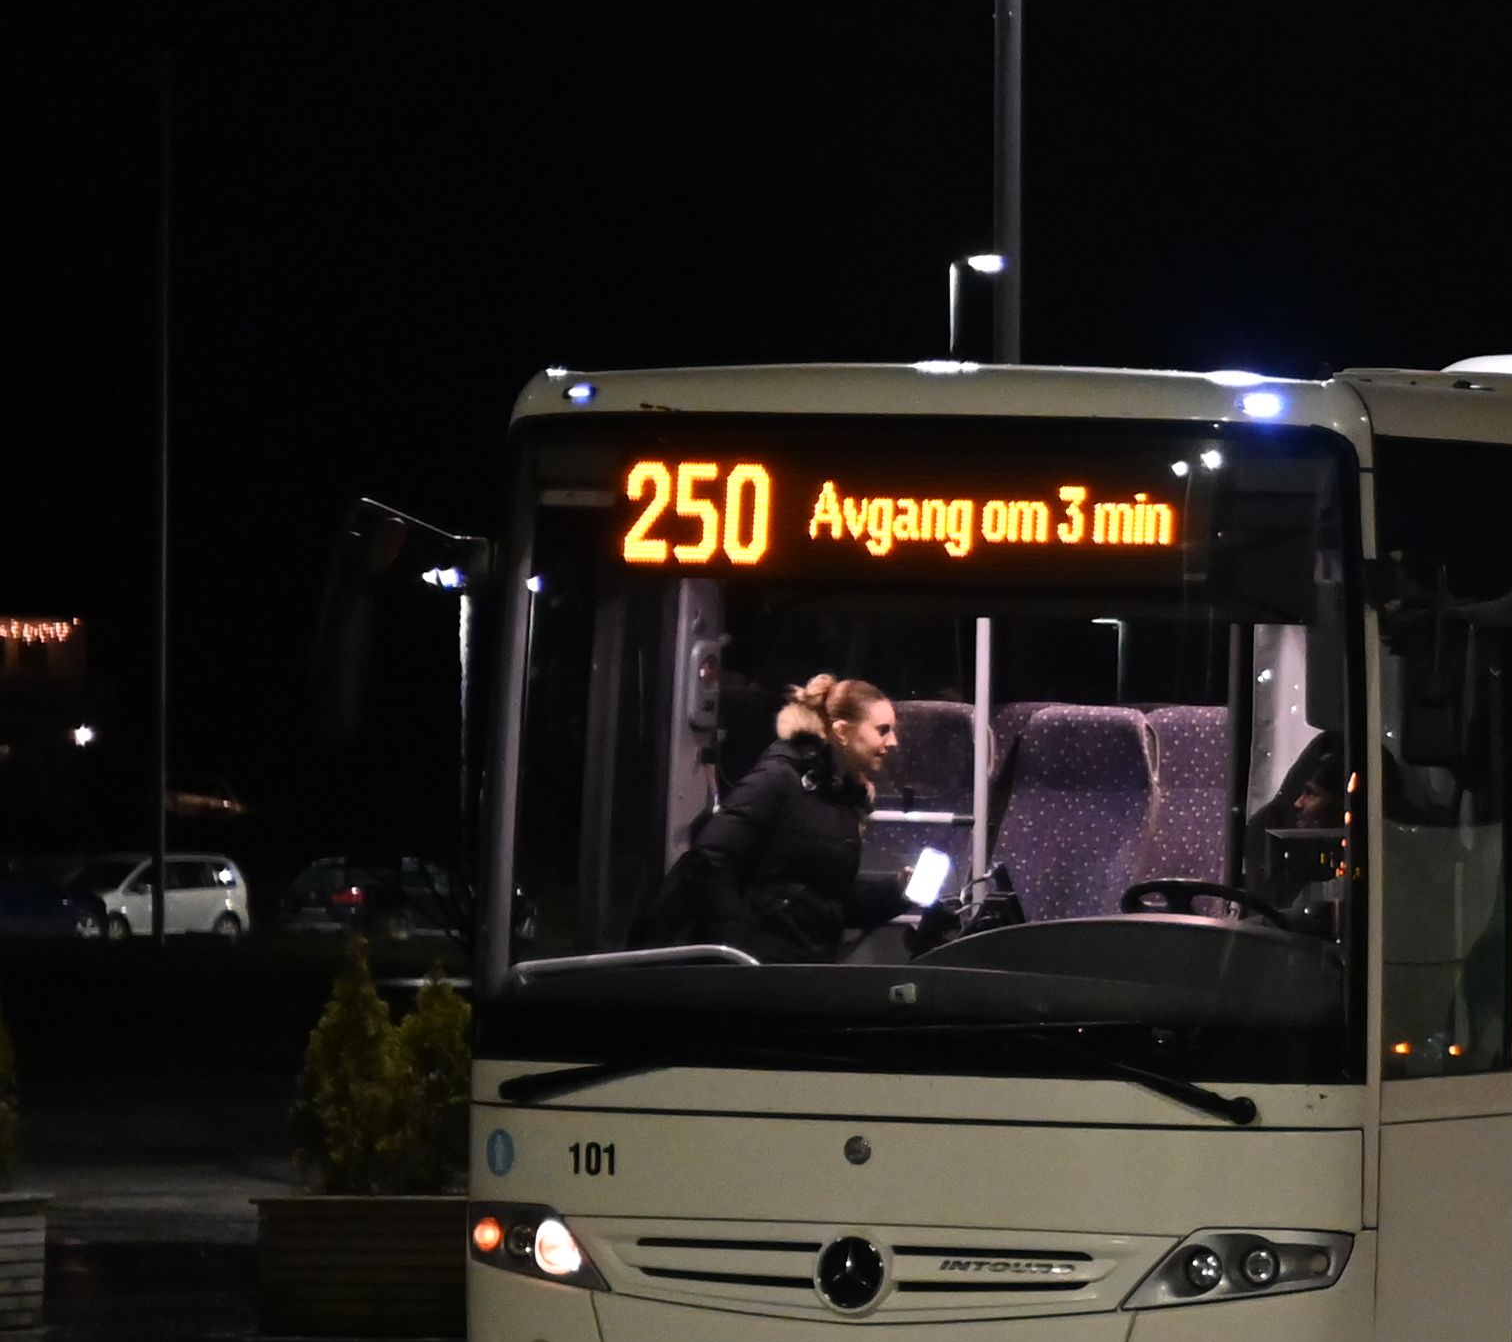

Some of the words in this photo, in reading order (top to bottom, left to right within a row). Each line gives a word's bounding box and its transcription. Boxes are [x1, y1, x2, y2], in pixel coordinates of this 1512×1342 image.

[624, 461, 770, 564] 250
[809, 480, 972, 557] Avgang
[981, 499, 1049, 543] om
[1057, 486, 1086, 543] 3
[1093, 492, 1174, 545] min
[569, 1142, 615, 1175] 101
